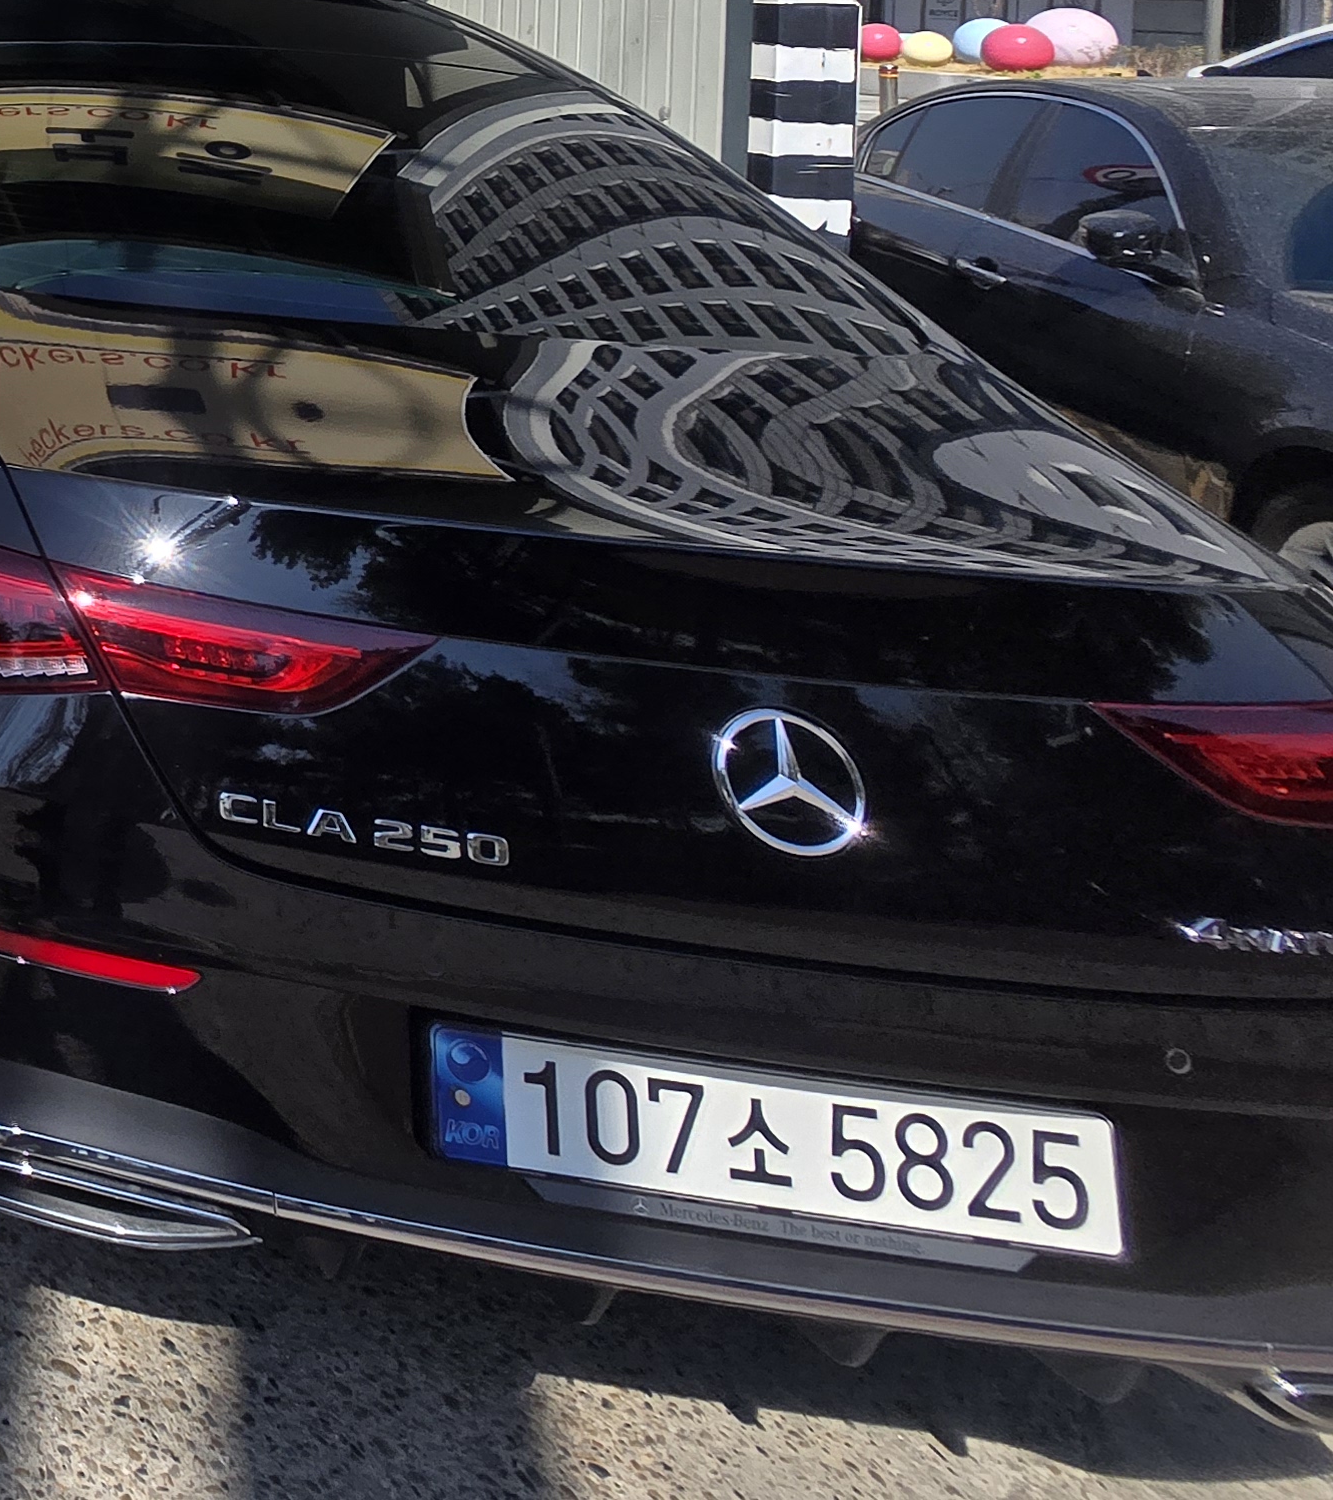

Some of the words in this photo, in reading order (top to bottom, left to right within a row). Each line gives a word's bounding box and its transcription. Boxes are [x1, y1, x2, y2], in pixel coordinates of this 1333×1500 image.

[219, 791, 357, 844] CLA
[373, 818, 510, 867] 250
[444, 1117, 500, 1150] KOR
[523, 1060, 793, 1188] 107소
[830, 1102, 1089, 1231] 5825
[659, 1201, 770, 1233] Mercedes-Benz
[779, 1219, 807, 1236] The
[811, 1223, 842, 1242] best
[845, 1231, 860, 1245] or
